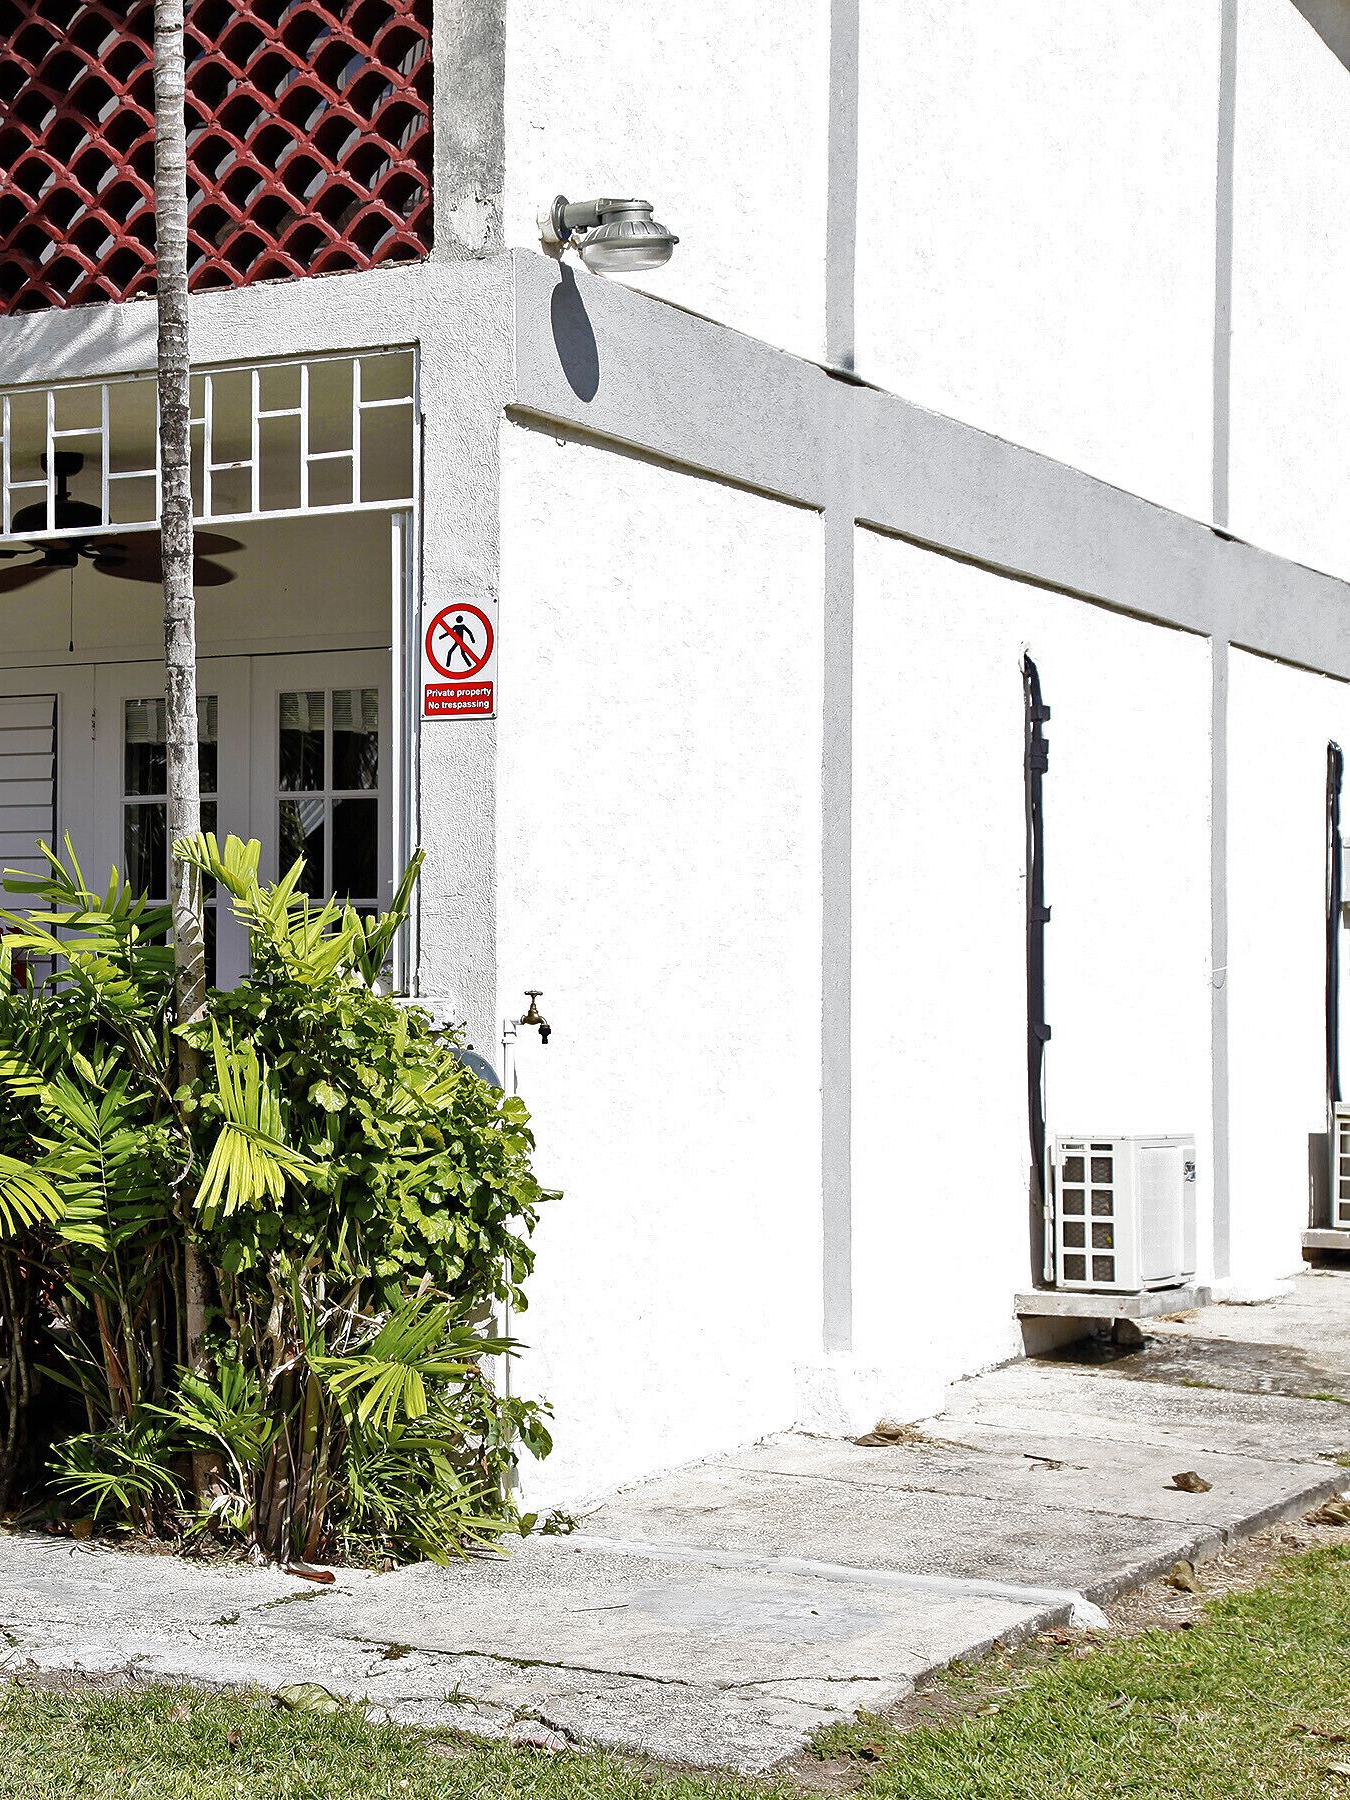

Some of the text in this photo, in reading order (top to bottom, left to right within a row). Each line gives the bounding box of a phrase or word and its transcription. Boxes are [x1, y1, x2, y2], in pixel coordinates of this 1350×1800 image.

[426, 688, 492, 697] Private property
[428, 700, 490, 709] No trespassing
